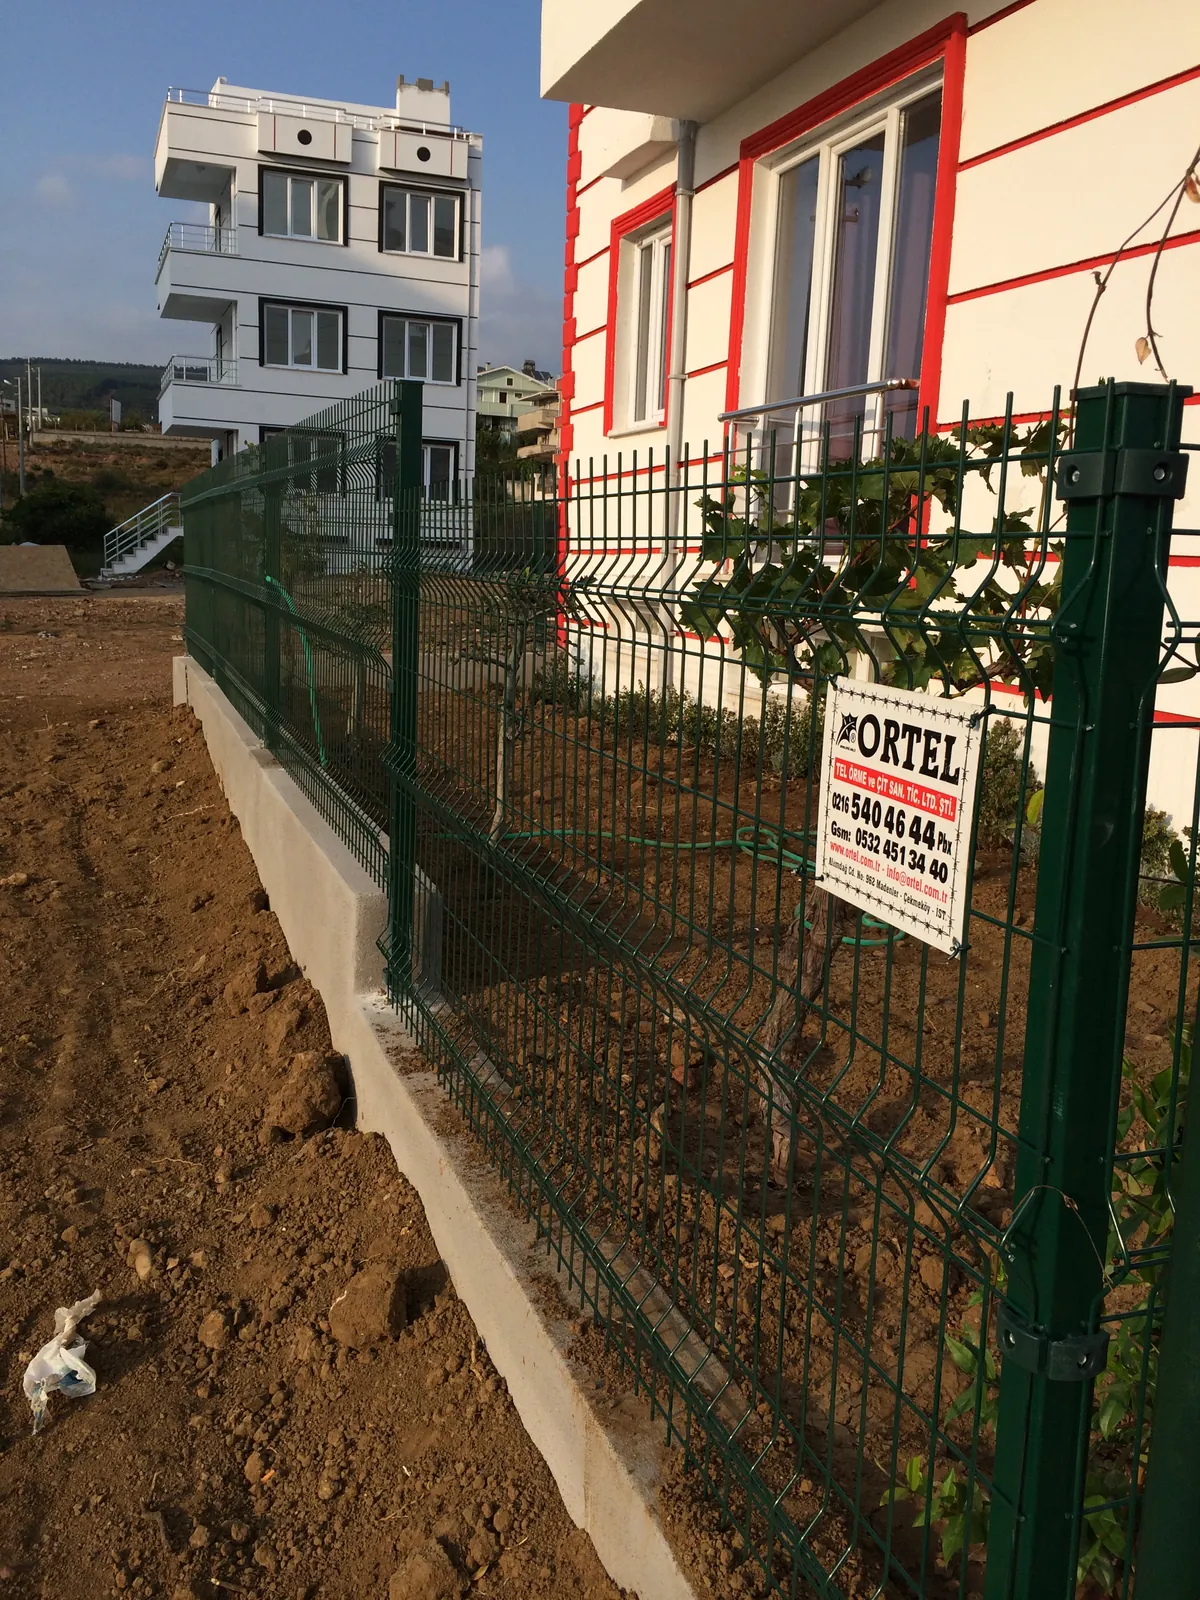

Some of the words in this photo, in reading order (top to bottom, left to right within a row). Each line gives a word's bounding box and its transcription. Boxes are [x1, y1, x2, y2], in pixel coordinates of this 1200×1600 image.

[858, 713, 960, 785] ORTEL
[836, 762, 847, 779] TEL
[849, 766, 867, 785] ÖRME
[868, 777, 876, 787] ve
[876, 774, 888, 794] ÇİT
[889, 783, 905, 799] SAN.
[907, 787, 920, 804] TİC.
[922, 792, 938, 810] LTD.
[939, 794, 953, 817] ŞTİ.
[831, 821, 851, 842] Gsm:
[855, 827, 880, 855] 0532
[883, 839, 905, 865] 451
[908, 849, 925, 874] 34
[930, 859, 948, 884] 40
[832, 792, 849, 814] 0216
[851, 792, 882, 828] 540
[884, 806, 905, 838] 46
[909, 815, 936, 851] 44
[938, 832, 952, 855] Pbx
[830, 841, 880, 872] www.ortel.com.tr
[886, 865, 948, 903] info@ortel.com.tr
[866, 875, 875, 887] 962
